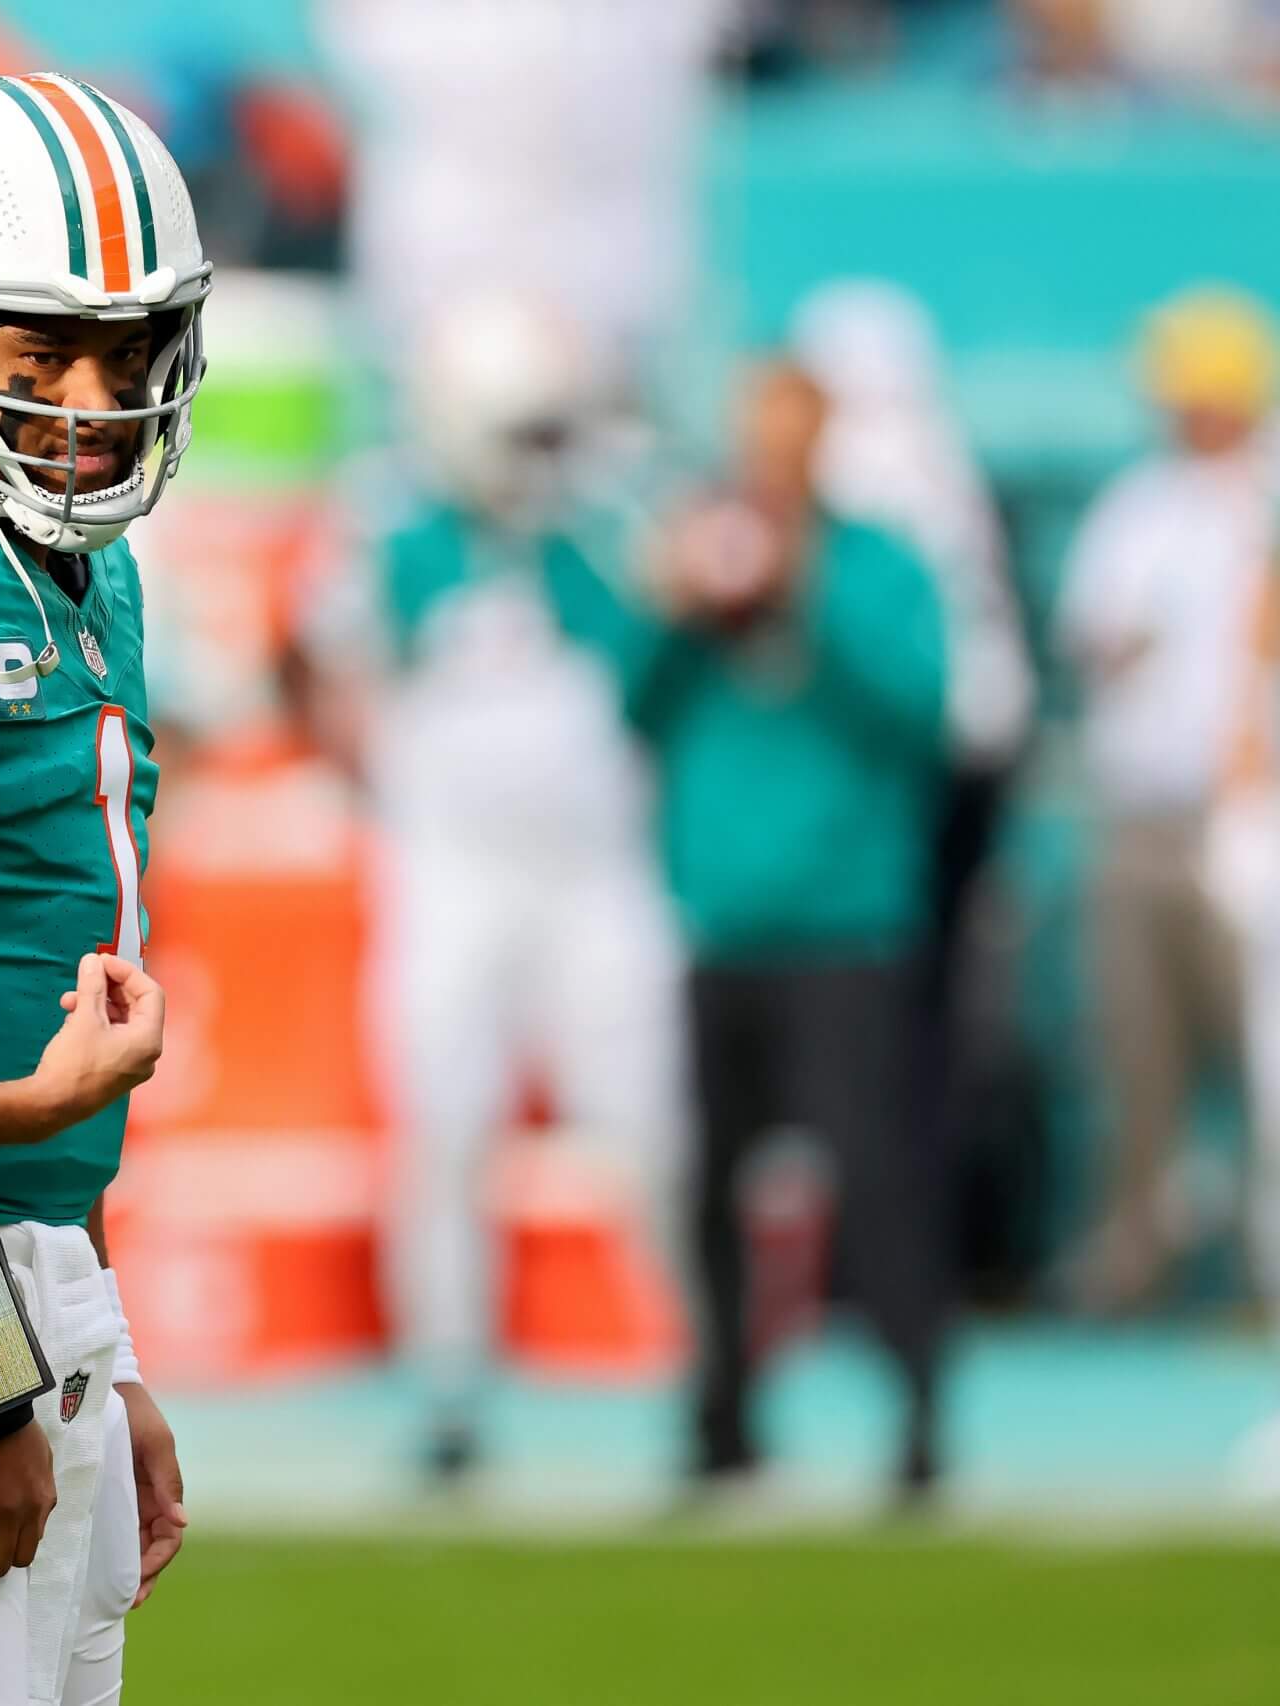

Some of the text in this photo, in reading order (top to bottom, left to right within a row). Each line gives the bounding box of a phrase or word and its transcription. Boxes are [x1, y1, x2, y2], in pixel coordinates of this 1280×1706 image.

[86, 651, 106, 672] NFL
[93, 704, 146, 974] 1
[61, 1392, 81, 1418] NFL
